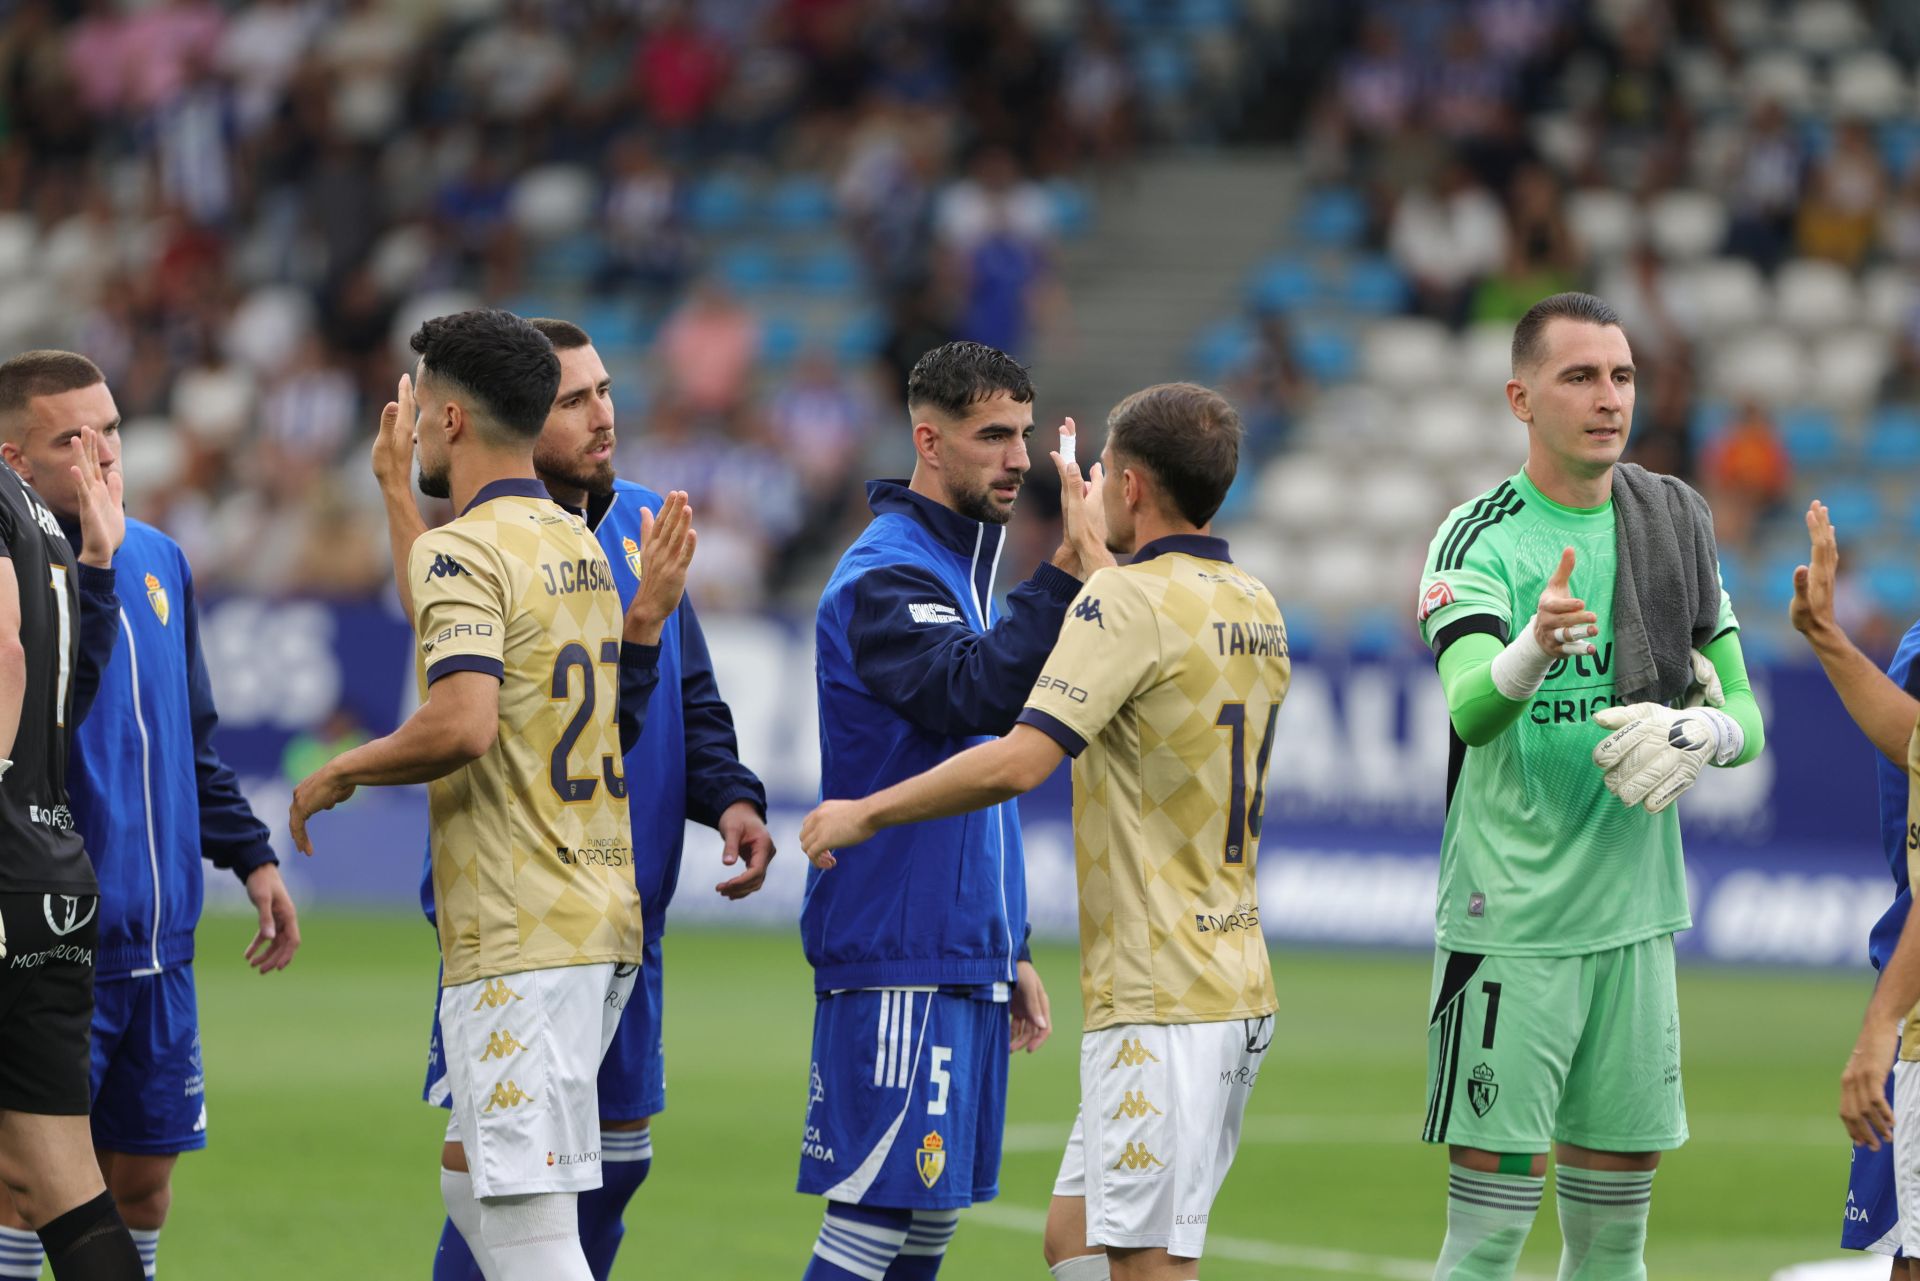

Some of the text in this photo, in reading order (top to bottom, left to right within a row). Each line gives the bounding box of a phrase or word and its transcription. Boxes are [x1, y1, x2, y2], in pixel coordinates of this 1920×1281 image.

[1212, 621, 1289, 658] TAVARES
[1481, 980, 1502, 1050] 1
[926, 1045, 953, 1116] 5
